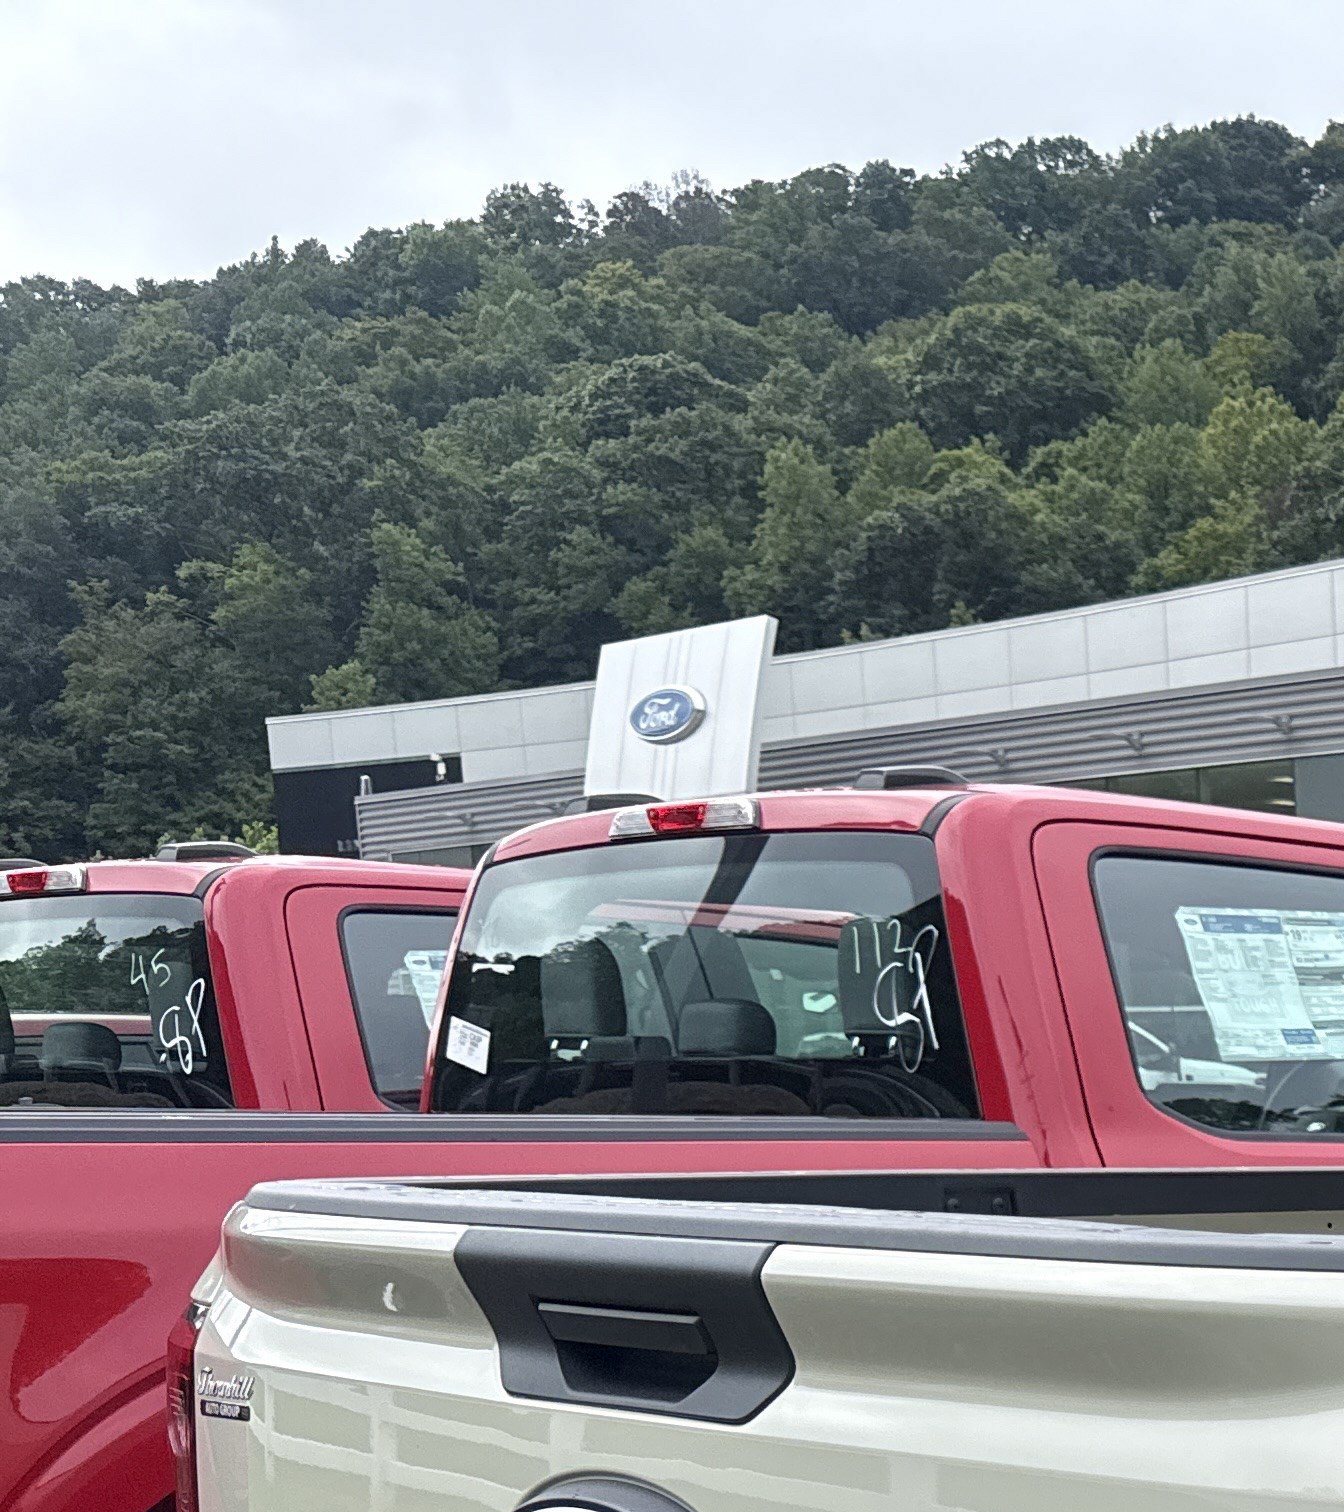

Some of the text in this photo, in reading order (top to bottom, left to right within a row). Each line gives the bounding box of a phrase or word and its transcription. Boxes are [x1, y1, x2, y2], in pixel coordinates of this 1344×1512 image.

[638, 696, 680, 731] Ford
[130, 947, 172, 995] 45
[197, 1367, 255, 1400] Thornhill
